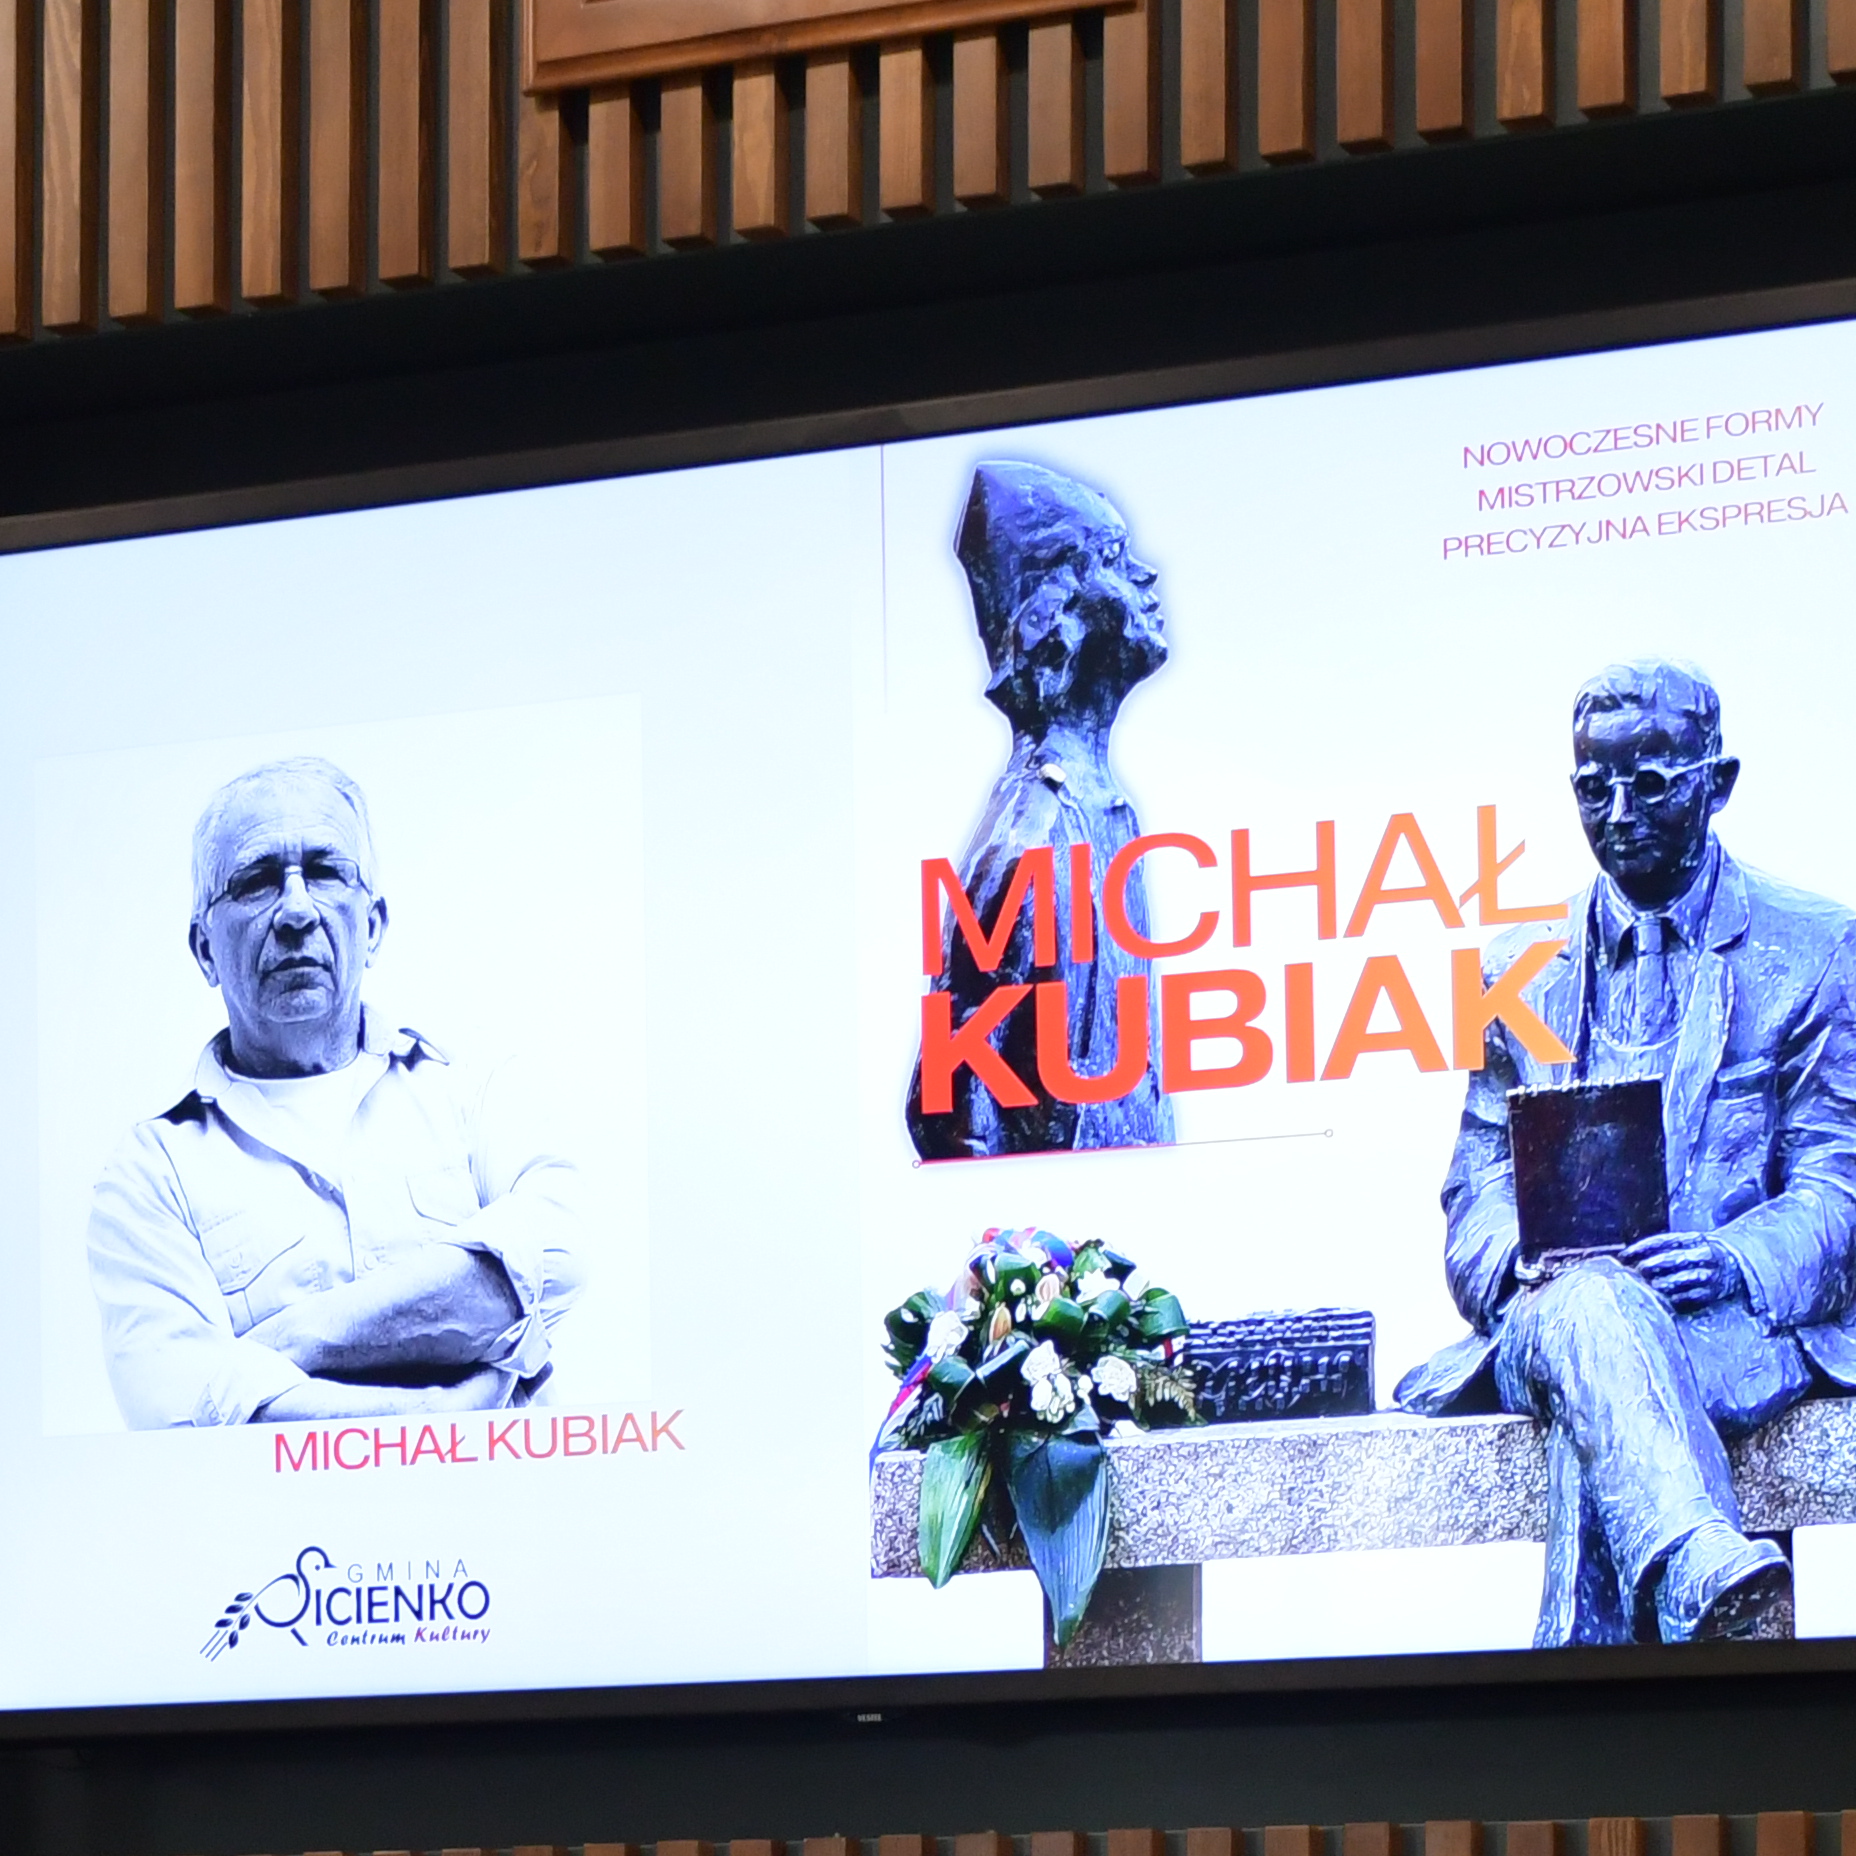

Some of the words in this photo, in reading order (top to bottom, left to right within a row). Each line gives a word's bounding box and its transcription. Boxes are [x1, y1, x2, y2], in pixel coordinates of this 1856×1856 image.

[1463, 418, 1700, 469] NOWOCZESNE
[1705, 402, 1825, 440] FORMY
[1477, 463, 1705, 511] MISTRZOWSKI
[1712, 451, 1817, 485] DETAL
[1443, 516, 1651, 561] PRECYZYJNA
[1657, 492, 1849, 536] EKSPRESJA
[920, 804, 1569, 977] MICHAŁ
[920, 938, 1578, 1115] KUBIAK
[274, 1422, 479, 1474] MICHAŁ
[488, 1409, 686, 1462] KUBIAK
[347, 1558, 469, 1584] GMINA
[326, 1628, 407, 1647] Centrum
[413, 1625, 491, 1644] Kultury
